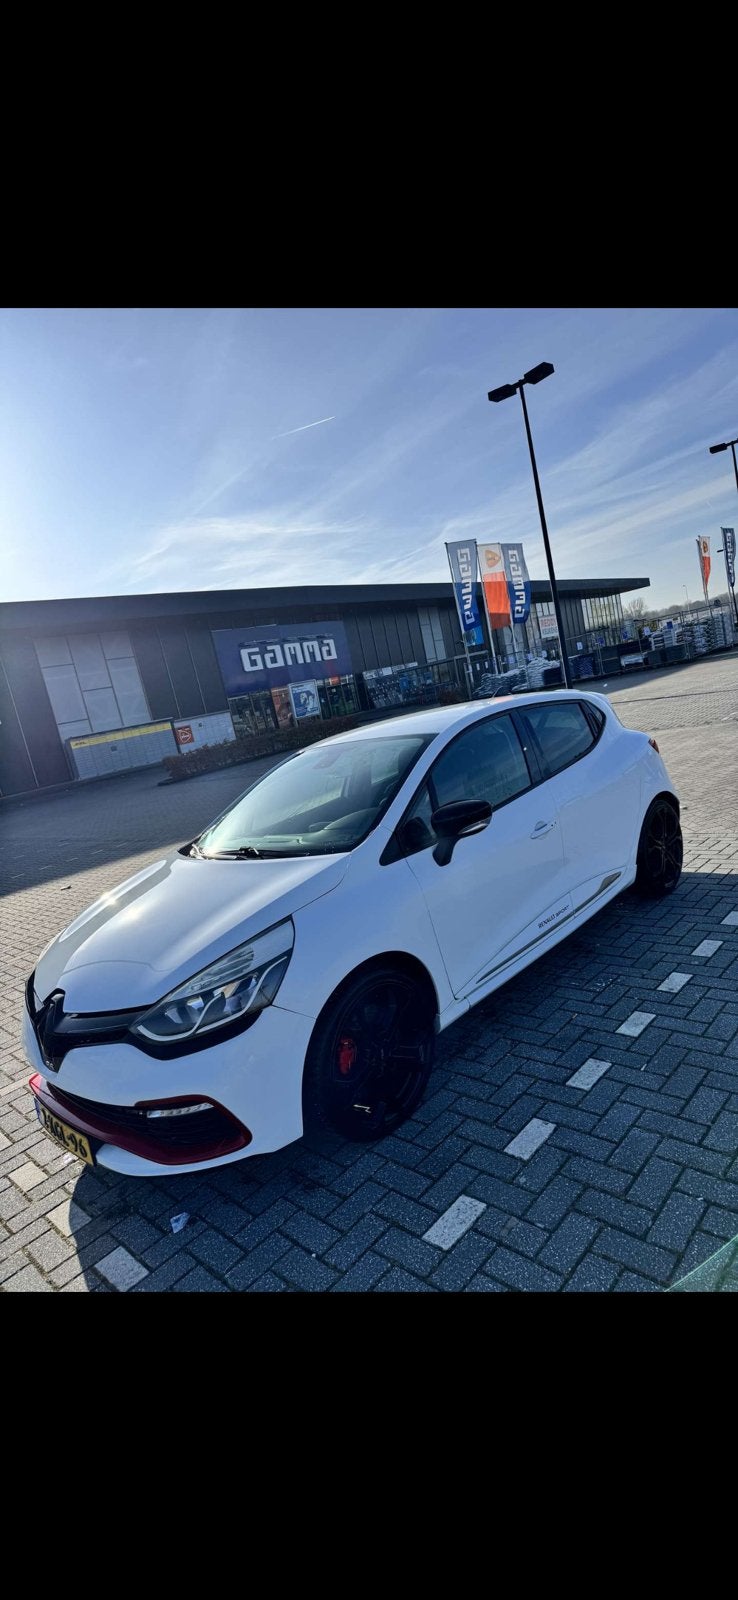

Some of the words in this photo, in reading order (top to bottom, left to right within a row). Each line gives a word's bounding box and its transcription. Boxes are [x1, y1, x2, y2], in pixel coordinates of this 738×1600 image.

[457, 548, 475, 625] GAMMA
[508, 550, 526, 619] GAMMA
[240, 638, 338, 672] GAMMA
